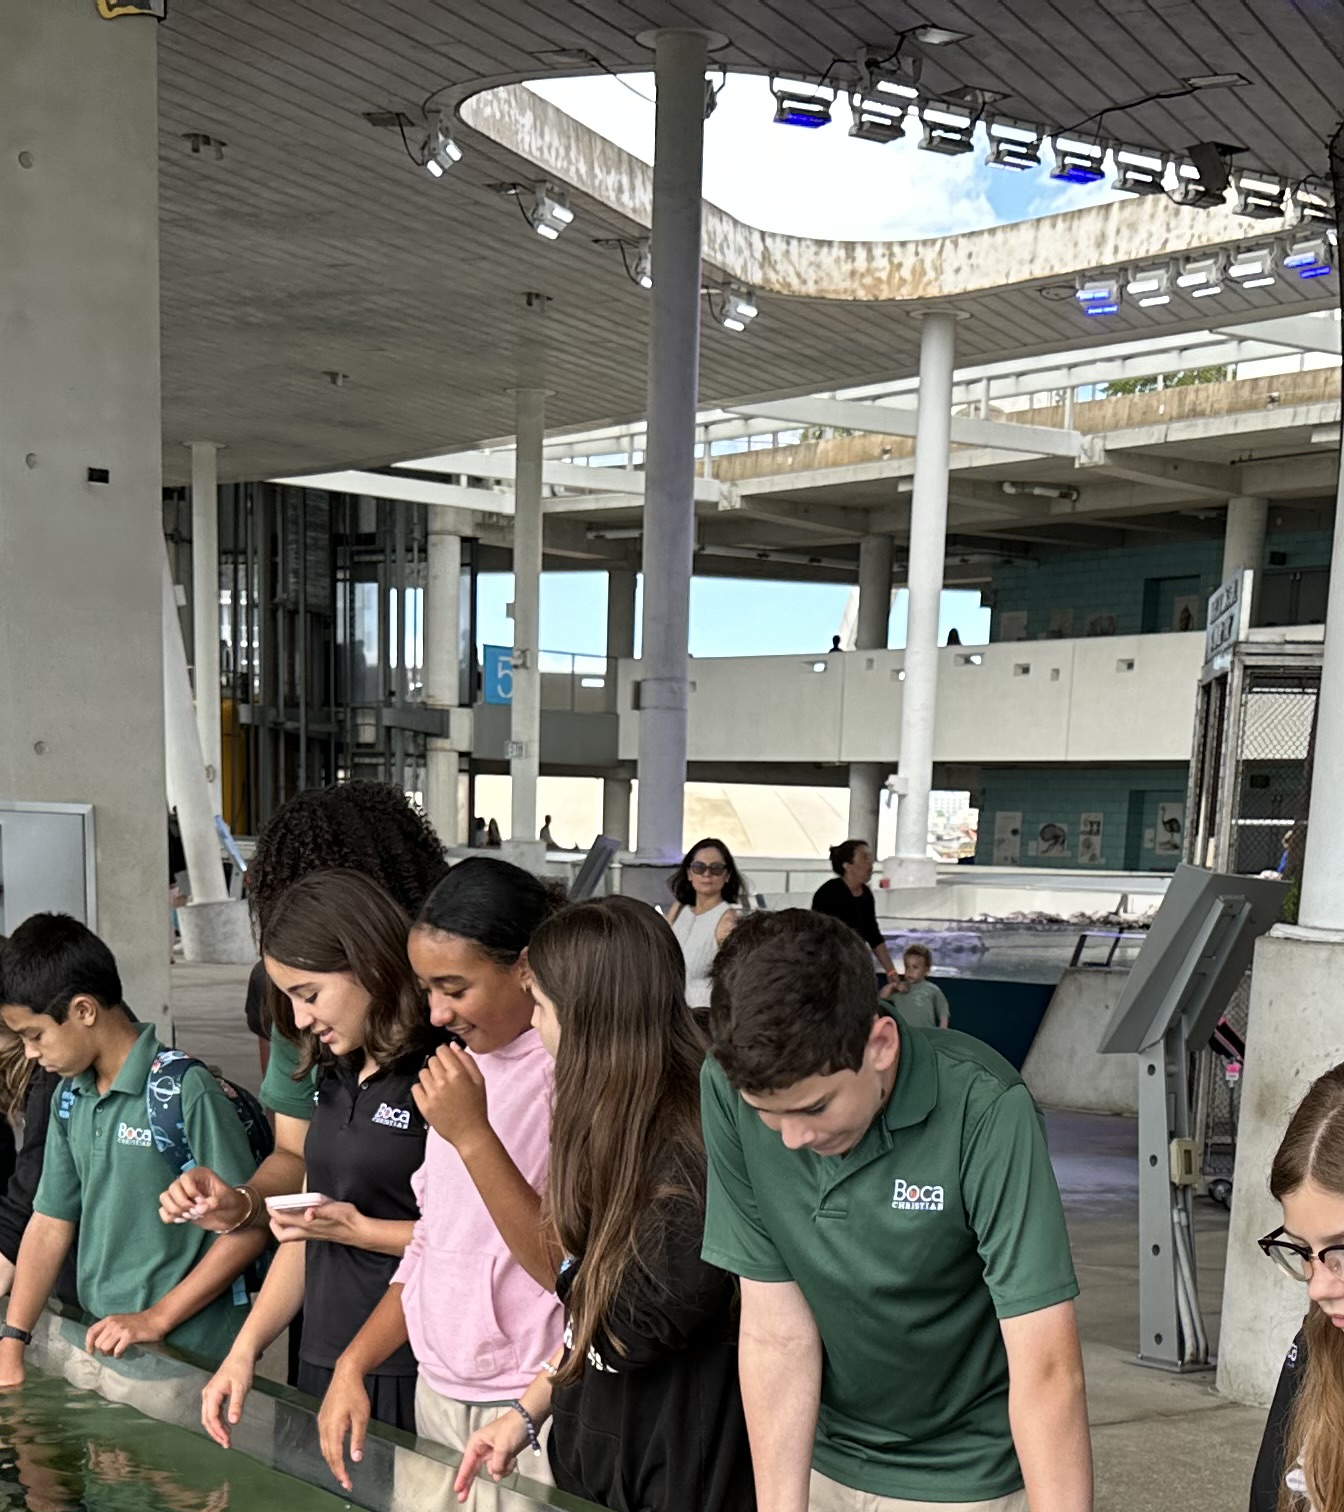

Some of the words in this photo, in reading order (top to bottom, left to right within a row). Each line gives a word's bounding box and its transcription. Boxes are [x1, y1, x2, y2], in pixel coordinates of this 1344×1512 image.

[497, 656, 514, 699] 5
[118, 1122, 152, 1141] Boca
[893, 1179, 944, 1202] Boca
[891, 1201, 944, 1211] CHRISTIAN
